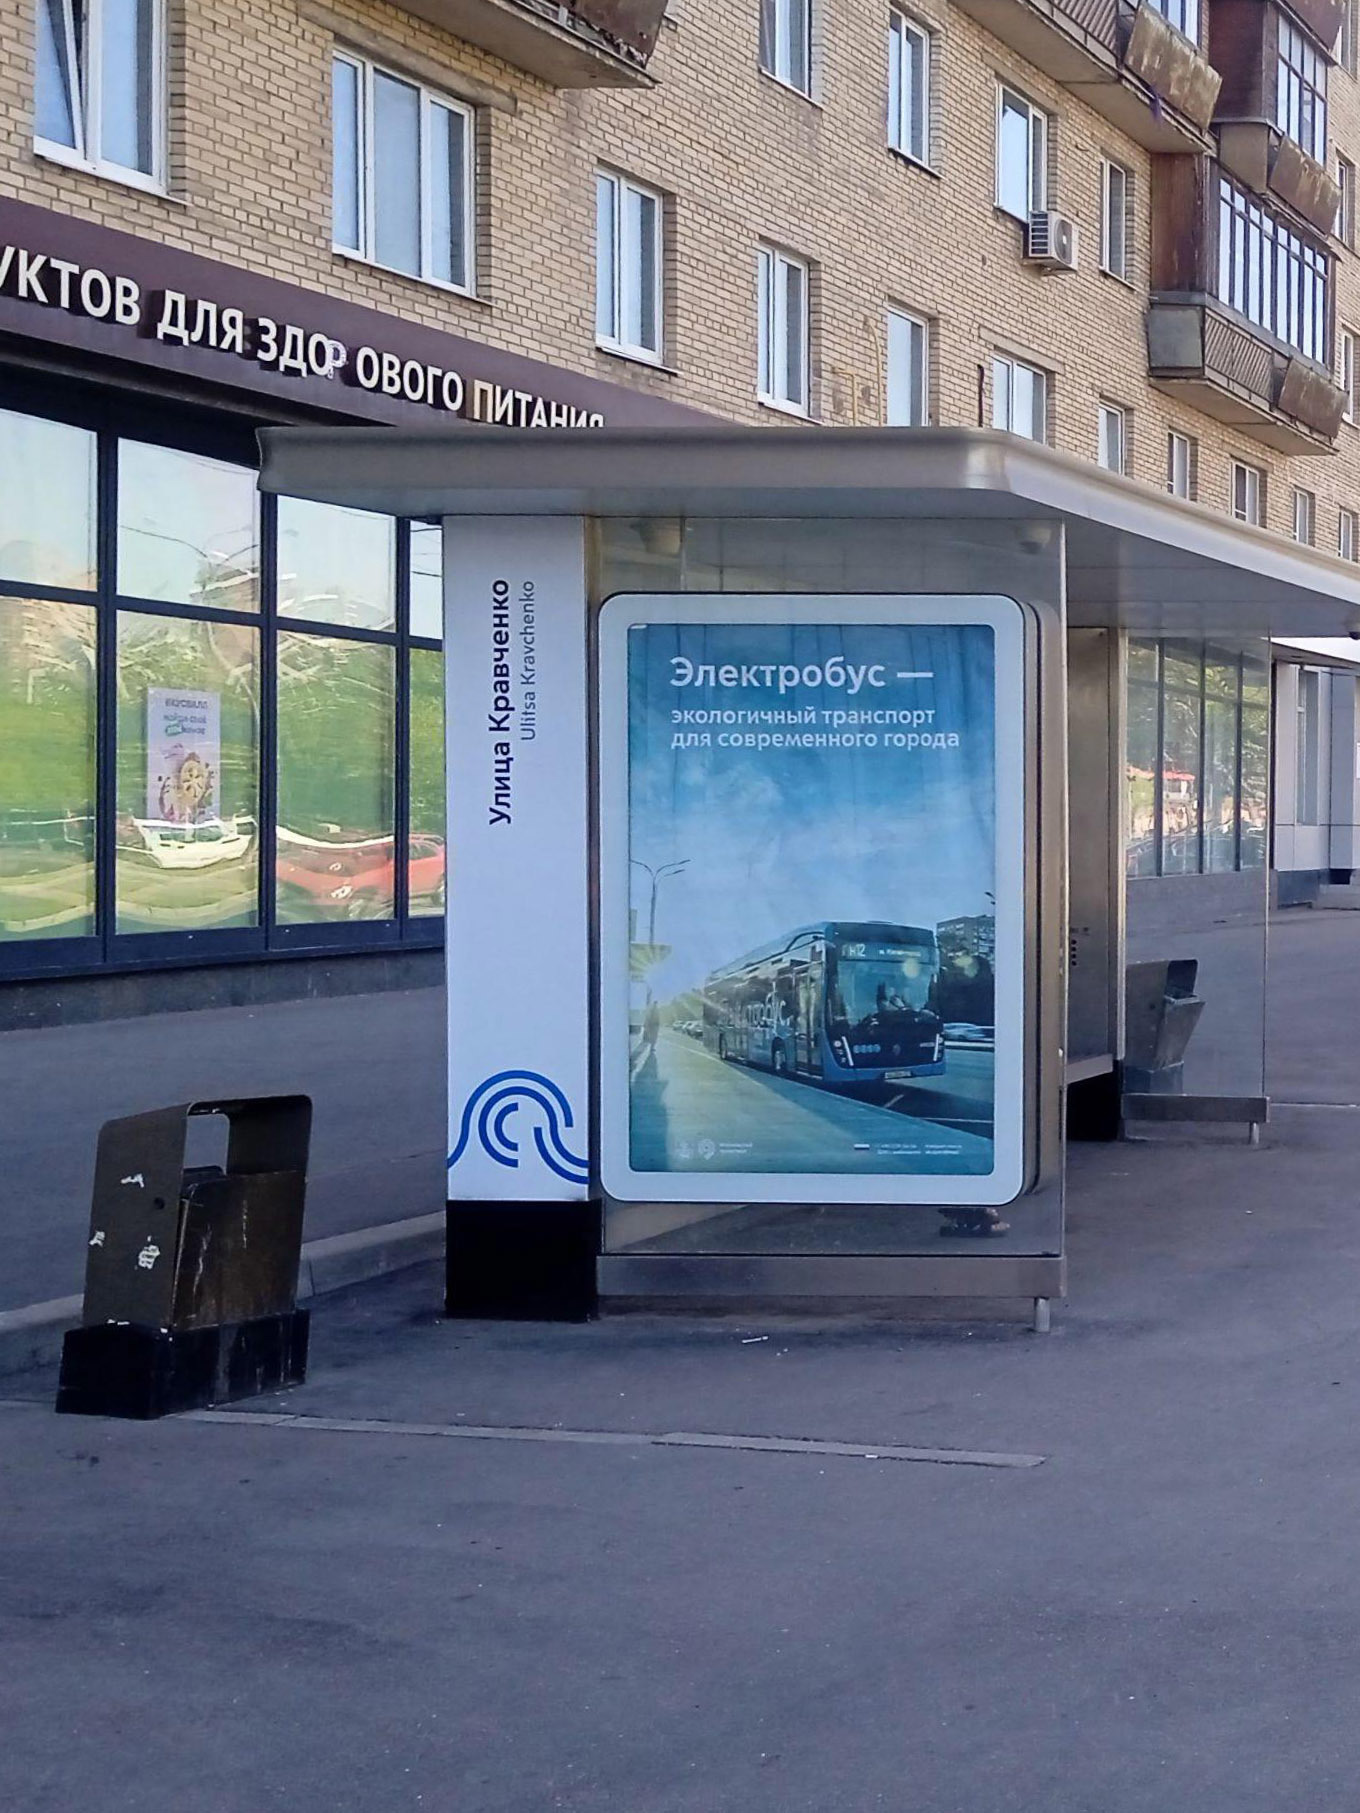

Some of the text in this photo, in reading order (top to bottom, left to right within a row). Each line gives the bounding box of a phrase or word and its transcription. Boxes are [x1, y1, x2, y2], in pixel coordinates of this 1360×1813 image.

[157, 289, 243, 353] ДЛЯ
[518, 580, 536, 741] Ulitsa Kravchenko
[670, 656, 887, 694] Электробус
[488, 579, 515, 825] Улица Кравченко
[671, 706, 935, 728] экологичный транспорт
[671, 732, 960, 751] для современного города
